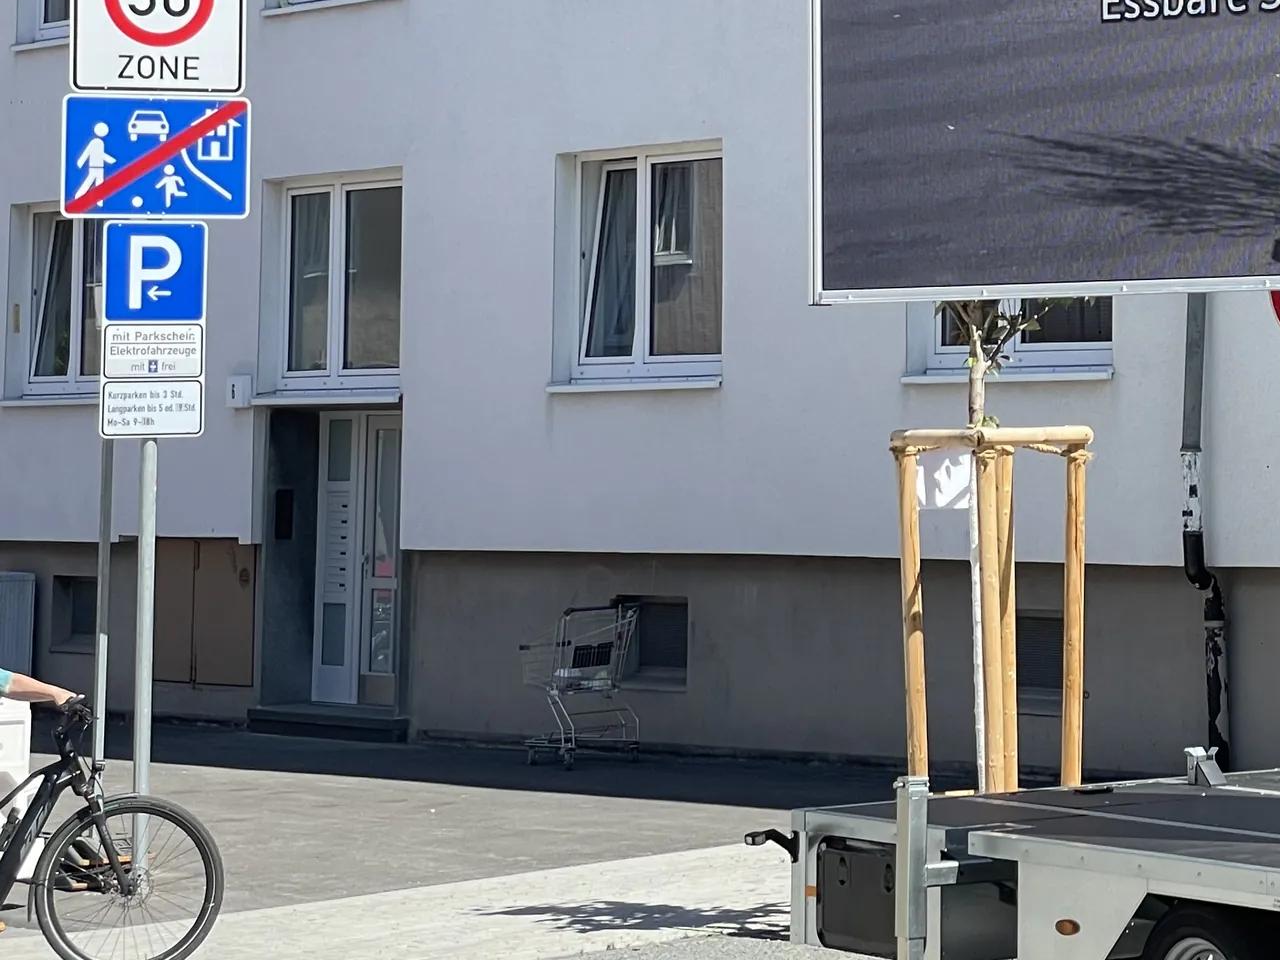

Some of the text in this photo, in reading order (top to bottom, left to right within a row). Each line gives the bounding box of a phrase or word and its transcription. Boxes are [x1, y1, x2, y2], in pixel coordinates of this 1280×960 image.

[117, 54, 200, 81] ZONE
[129, 235, 182, 309] P
[112, 331, 195, 341] mit Parkschein
[110, 345, 197, 357] Elektrofahrzeuge
[131, 362, 176, 371] mit frei
[108, 390, 184, 400] Kurzparken bis 3 Std.
[147, 404, 157, 412] bis
[107, 418, 130, 427] Mo-Sa
